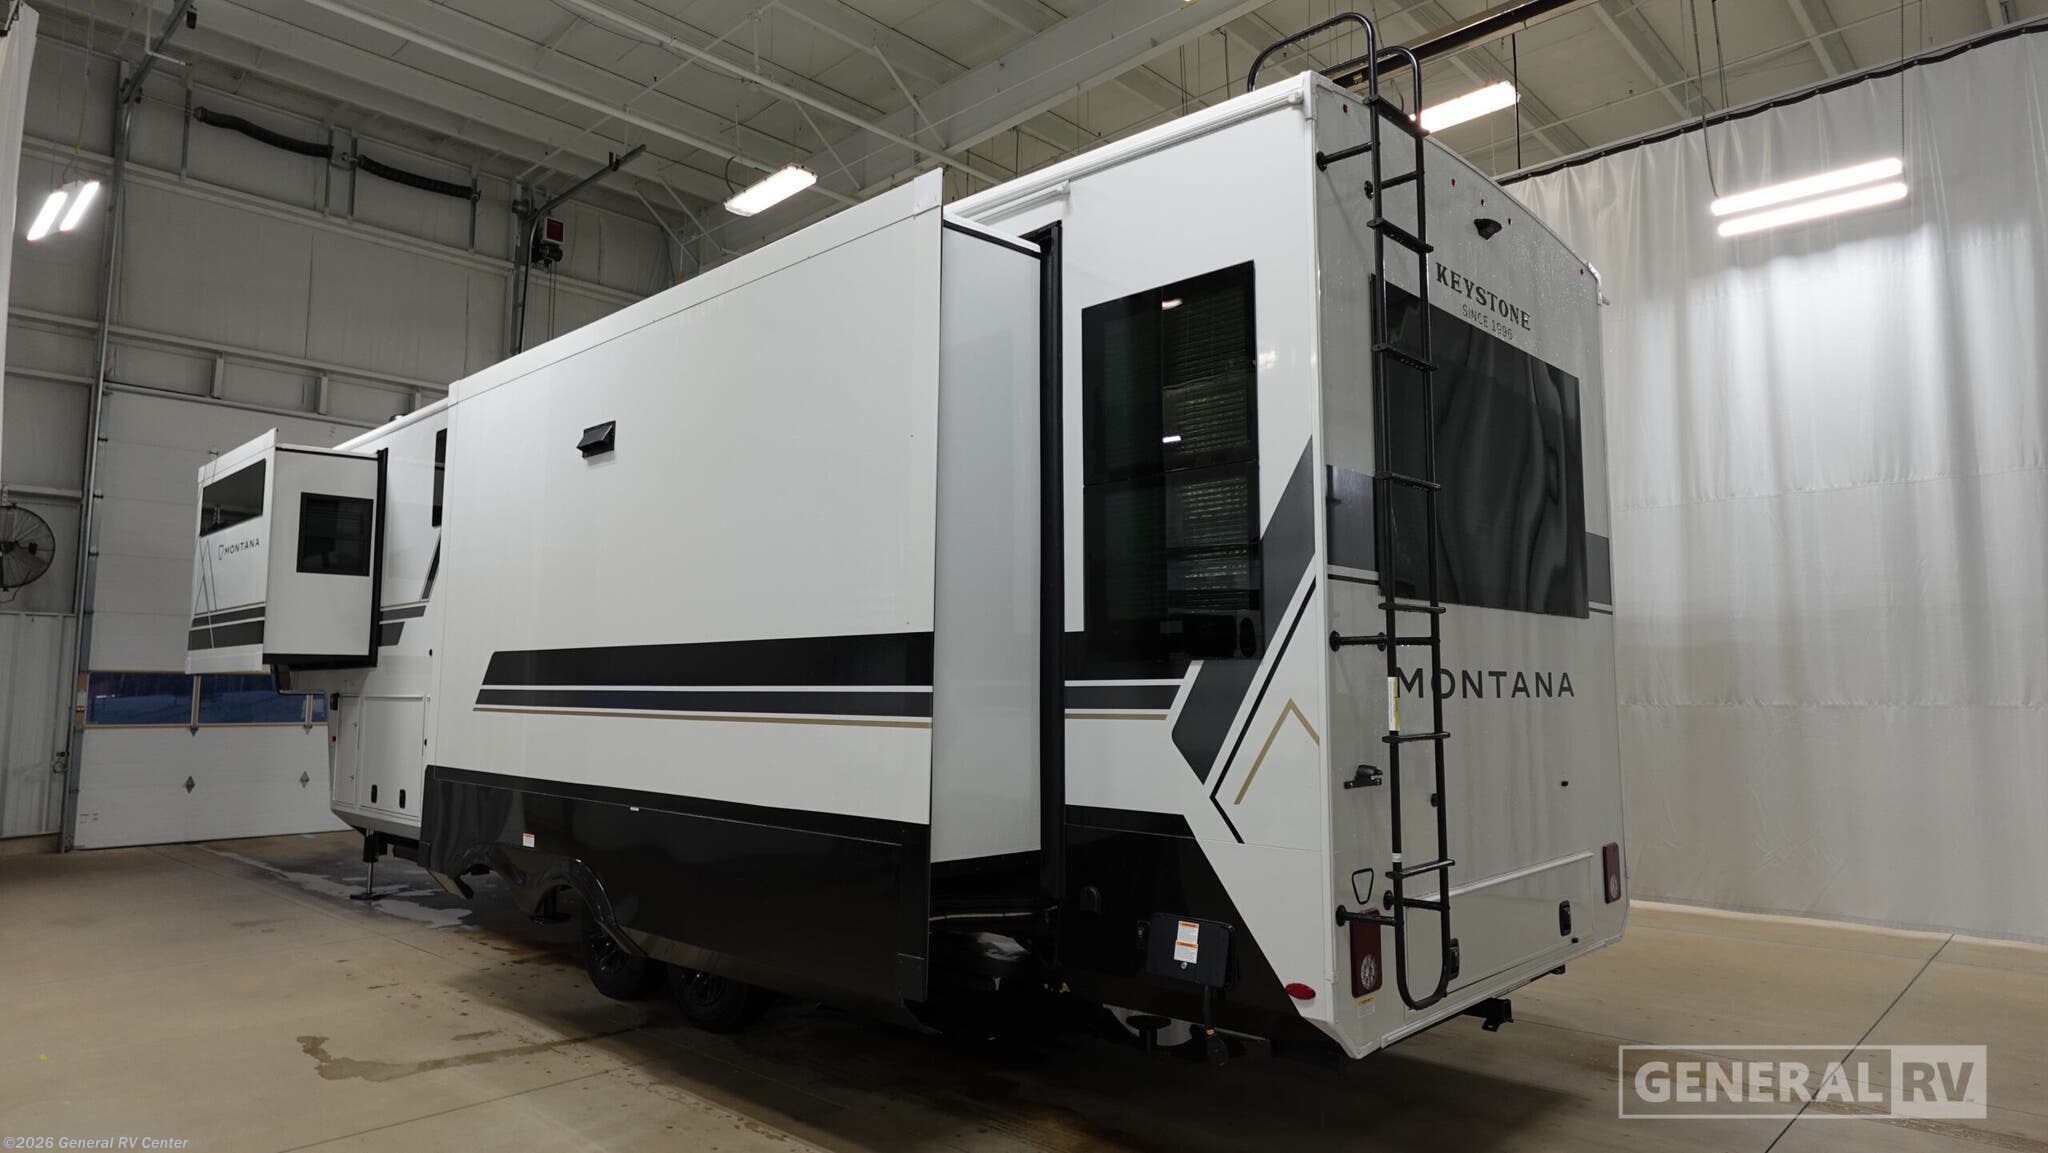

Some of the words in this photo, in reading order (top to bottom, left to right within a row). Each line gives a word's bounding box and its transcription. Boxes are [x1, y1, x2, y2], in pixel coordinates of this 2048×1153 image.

[1436, 262, 1531, 331] KEYSTONE
[1462, 304, 1489, 328] SINCE
[224, 538, 261, 555] MONTANA
[1396, 667, 1575, 699] MONTANA
